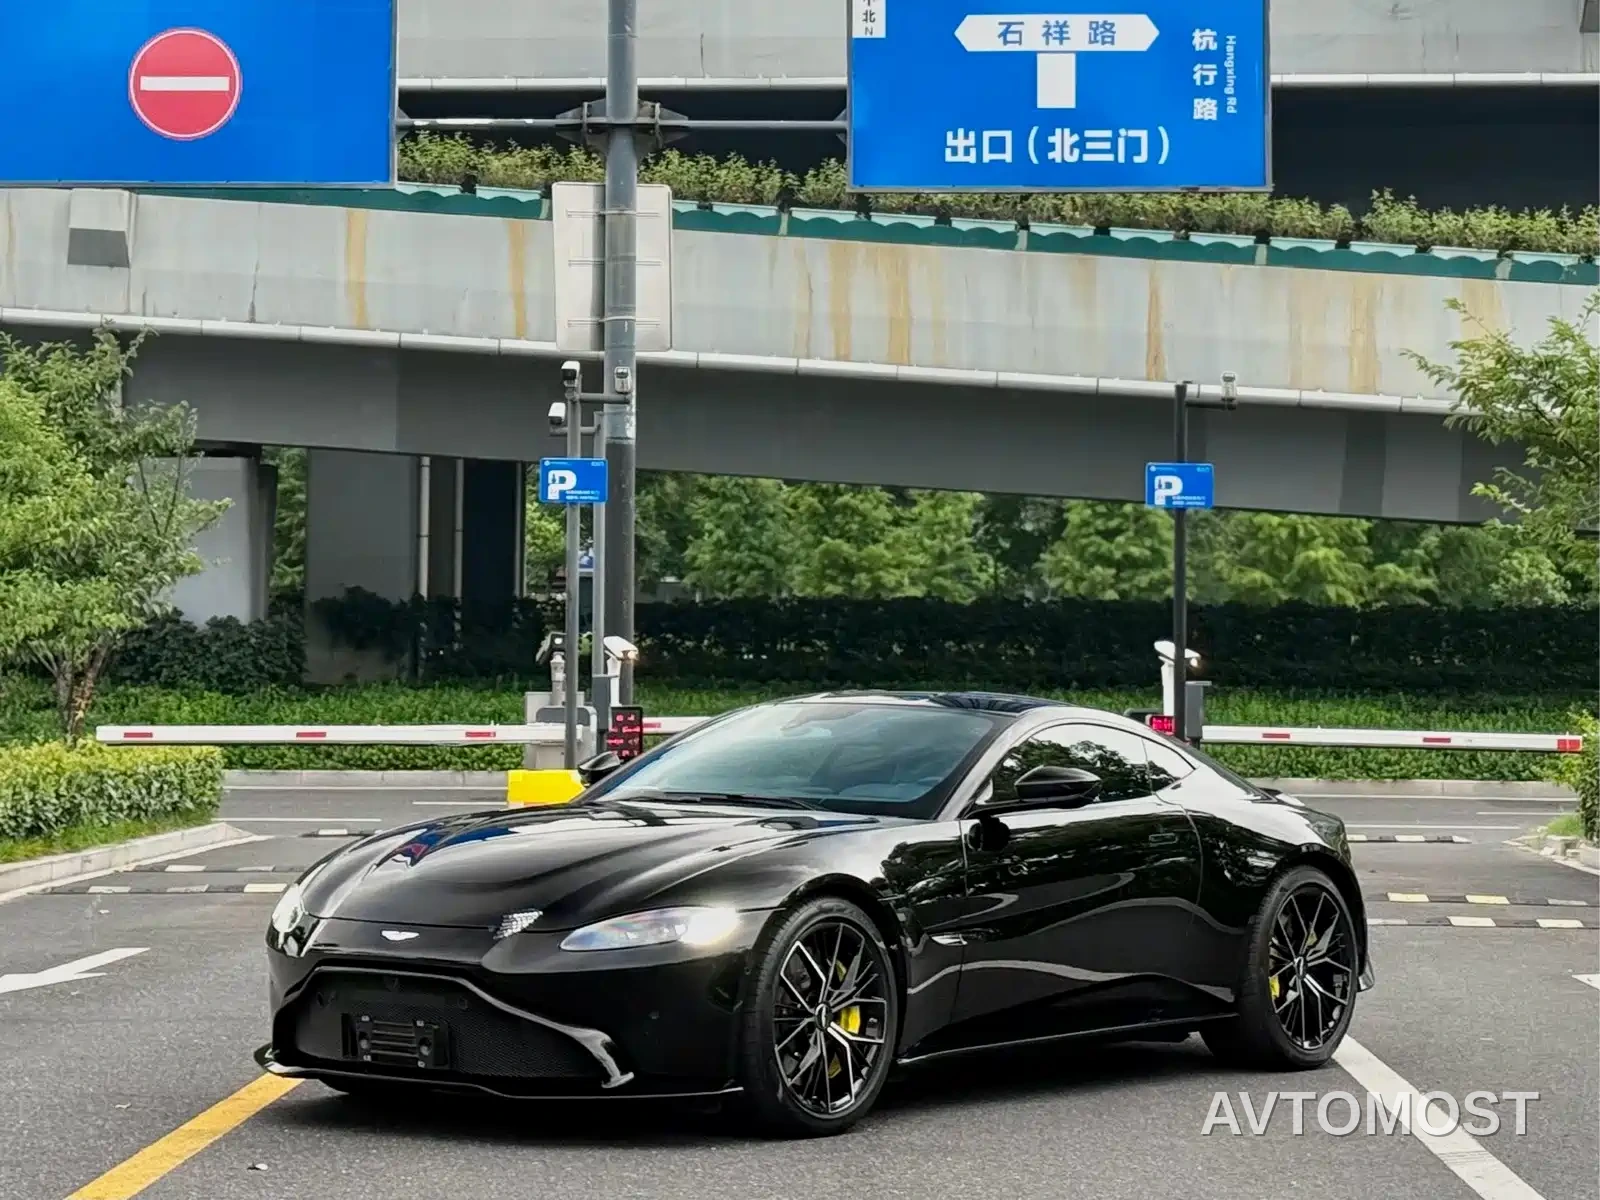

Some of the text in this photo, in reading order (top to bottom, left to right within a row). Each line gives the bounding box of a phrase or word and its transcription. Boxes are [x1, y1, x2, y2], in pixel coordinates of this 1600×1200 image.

[861, 9, 876, 23] 北
[864, 26, 873, 36] N
[997, 20, 1116, 46] 石祥路
[1192, 28, 1218, 120] 杭行路
[1223, 35, 1238, 114] Hangxing Rd
[547, 469, 578, 500] P
[1154, 475, 1184, 505] P
